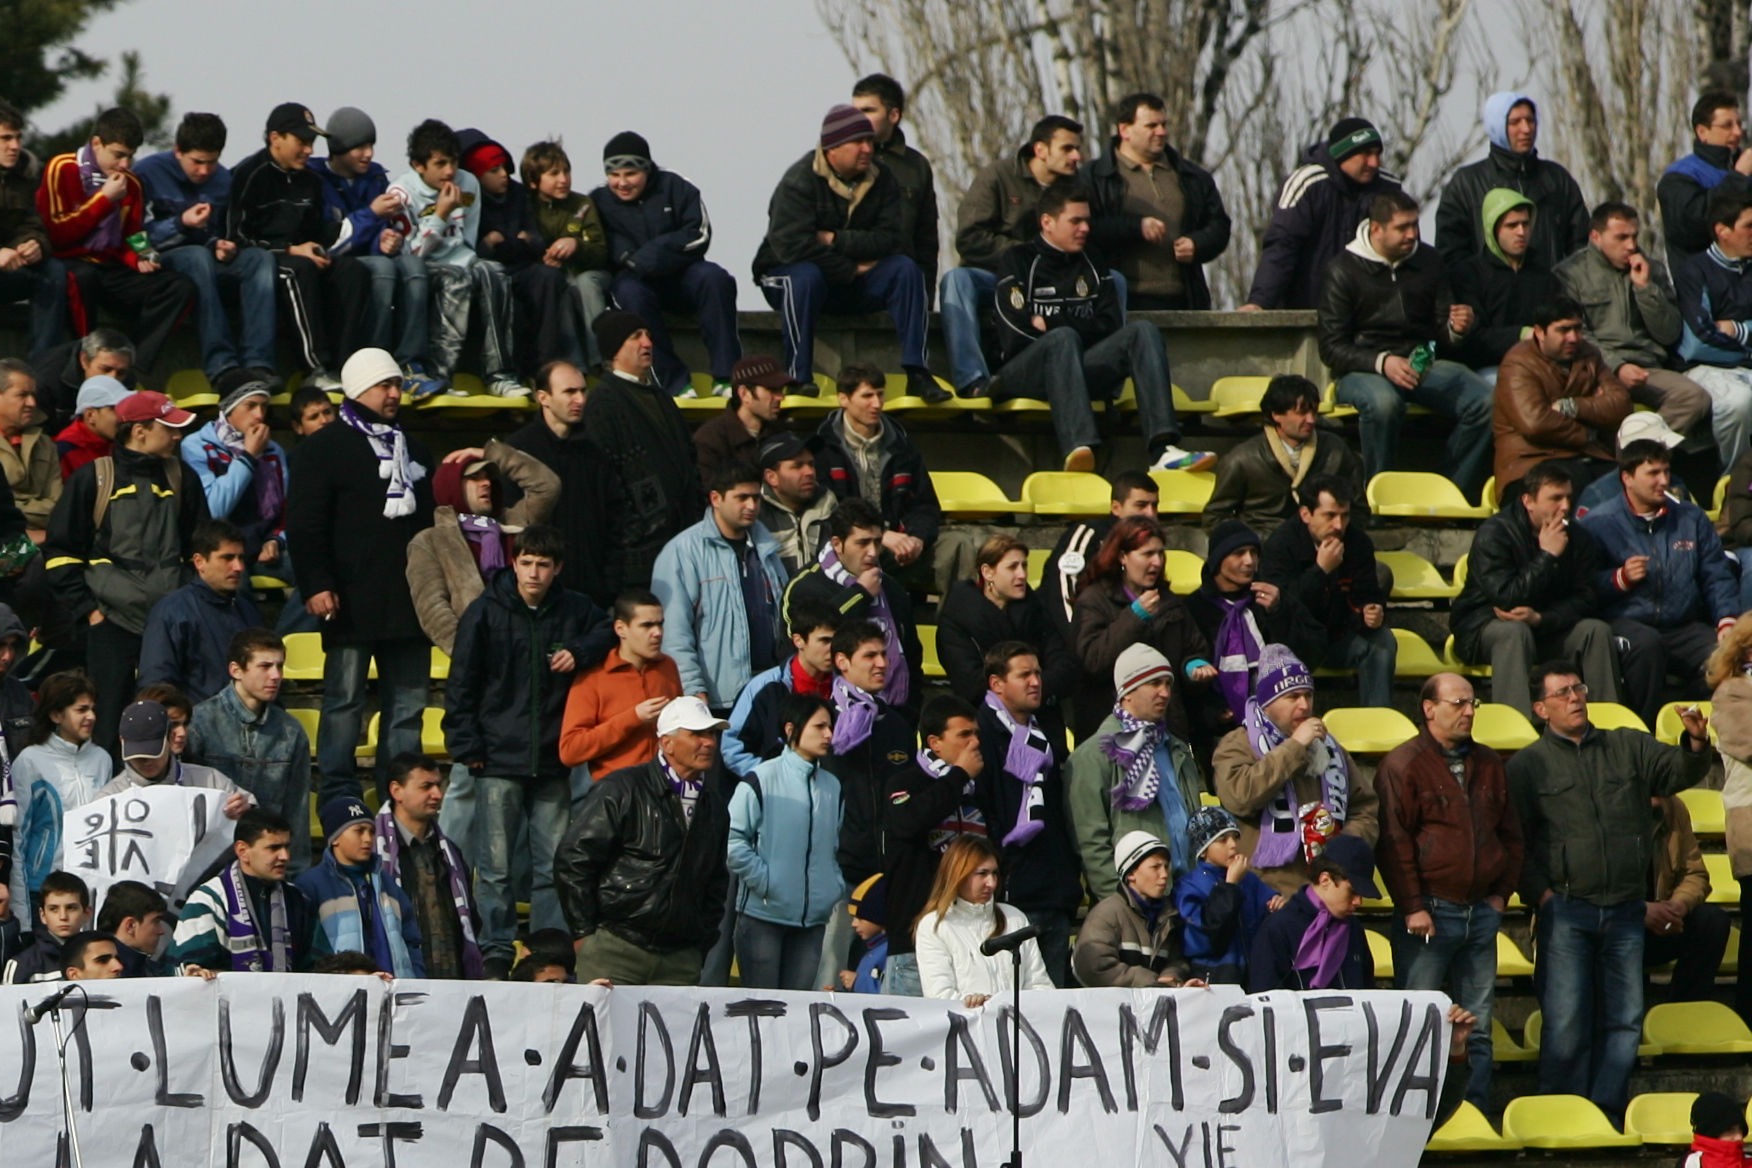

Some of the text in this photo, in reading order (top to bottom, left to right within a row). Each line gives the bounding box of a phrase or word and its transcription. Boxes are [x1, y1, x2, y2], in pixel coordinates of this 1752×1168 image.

[146, 987, 508, 1112] LUMEA
[543, 1002, 610, 1115] A
[634, 998, 788, 1119] DAT
[807, 1002, 916, 1121] PE
[945, 995, 1184, 1117] ADAM
[1304, 995, 1442, 1118] EVA
